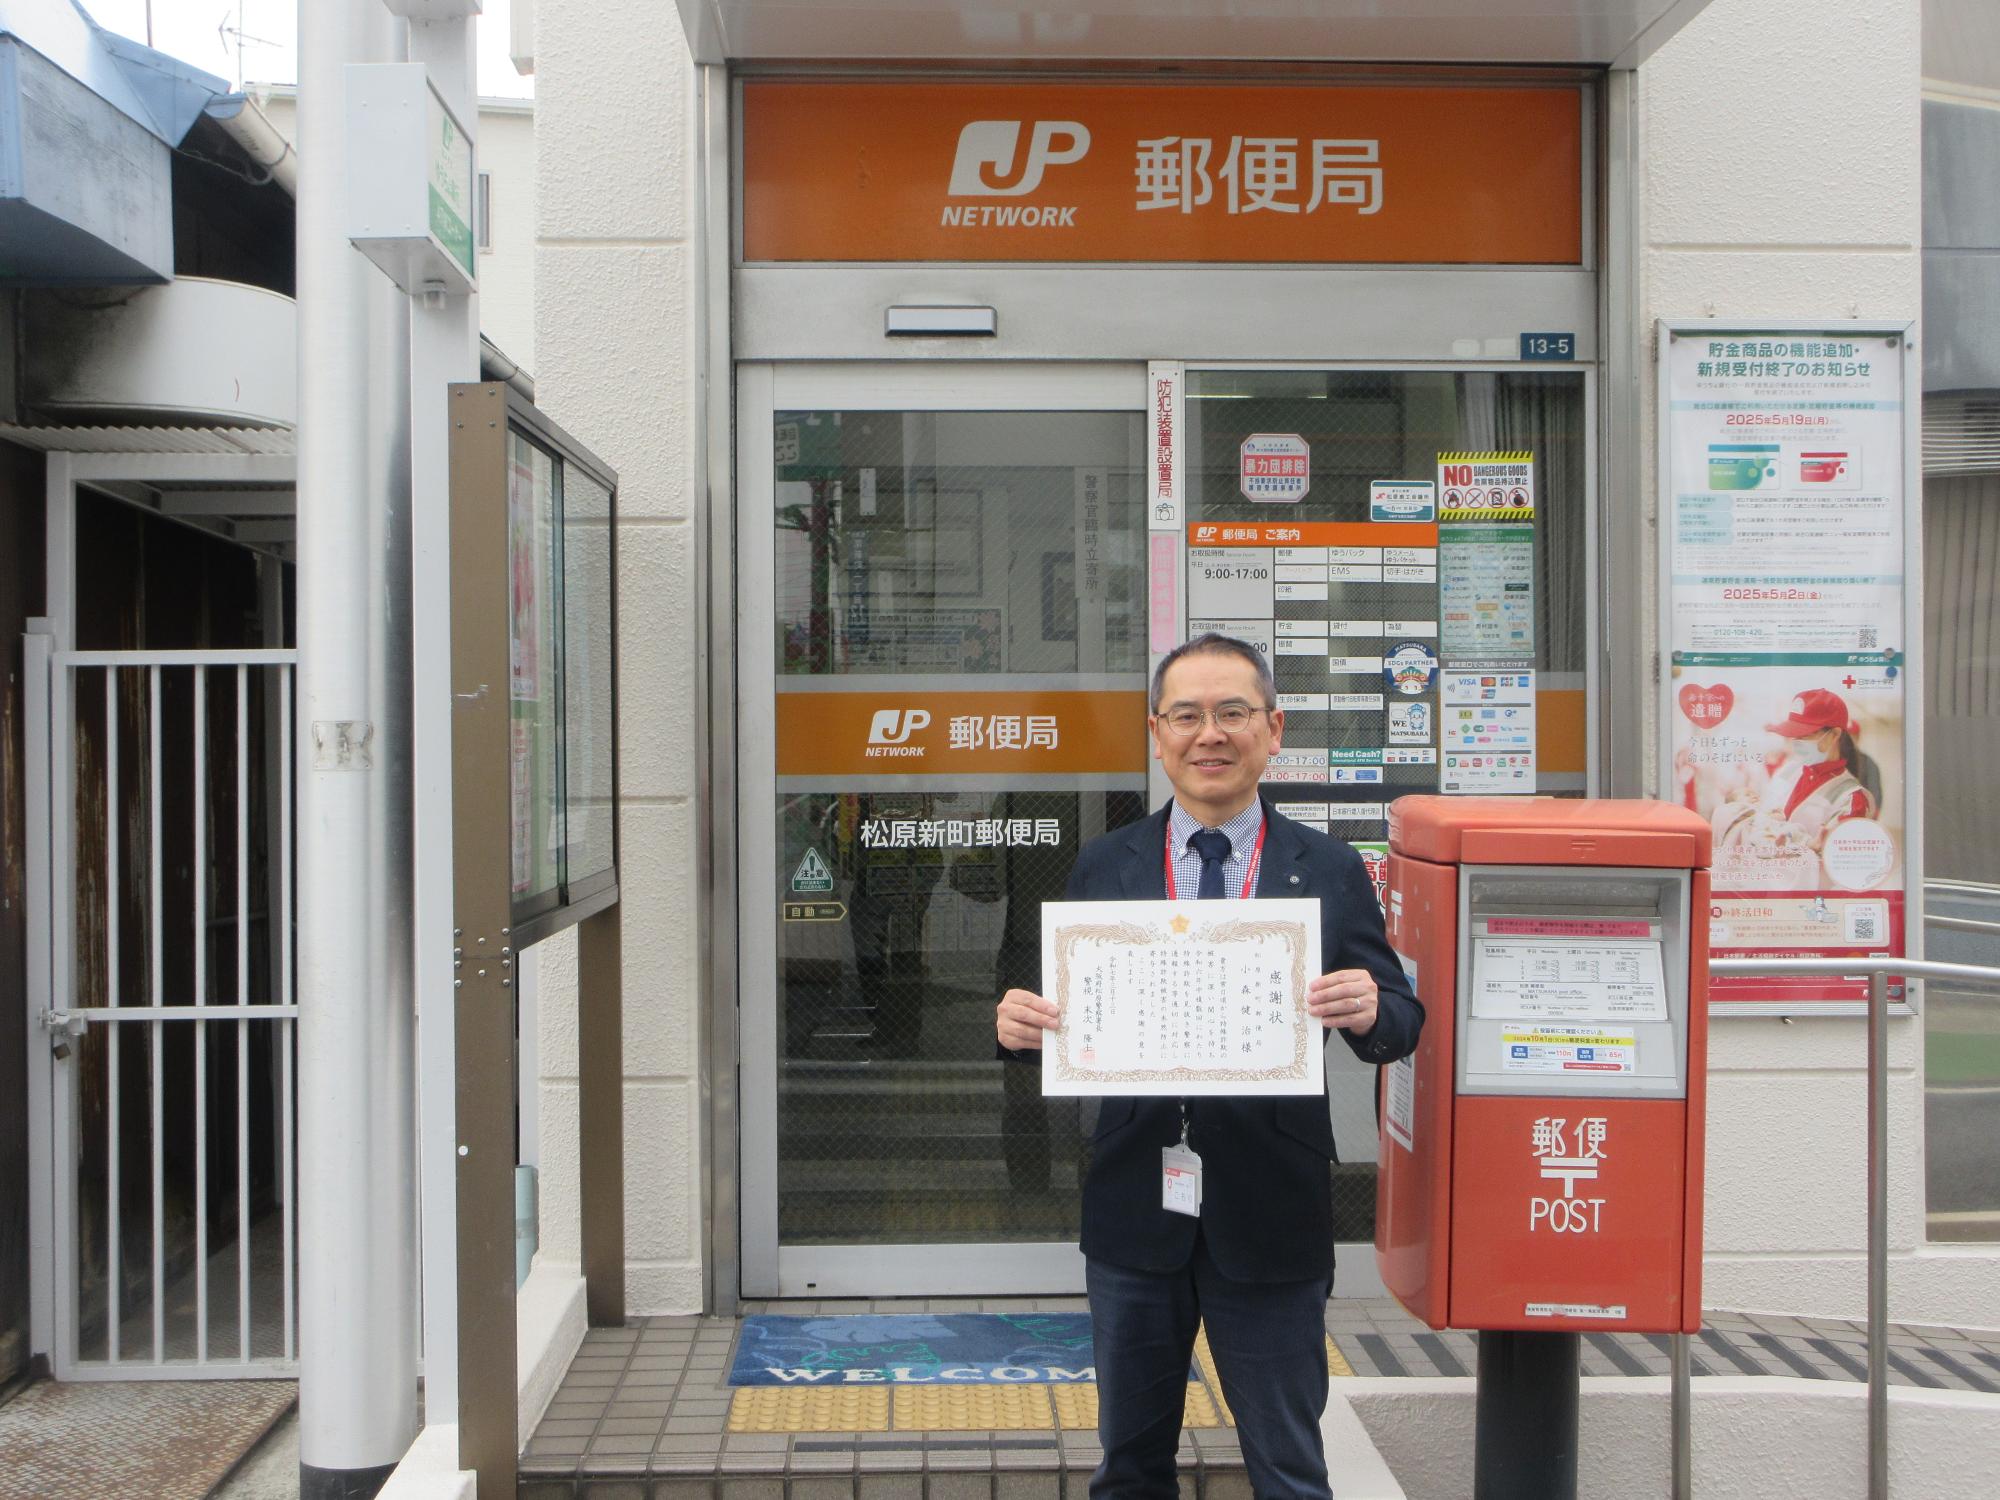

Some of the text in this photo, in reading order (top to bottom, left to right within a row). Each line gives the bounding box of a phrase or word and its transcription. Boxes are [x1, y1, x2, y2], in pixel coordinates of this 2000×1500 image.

[948, 120, 1090, 196] JP
[1134, 136, 1384, 215] 郵便局
[941, 207, 1078, 227] NETWORK
[1529, 339, 1568, 353] 13-5
[1697, 362, 1871, 377] 新規受付終了のお知らせ
[1157, 380, 1172, 498] 防犯装置設置局
[1245, 458, 1305, 474] 暴力団排除
[1444, 465, 1528, 486] NO DANGEROUS GOODS
[1084, 474, 1098, 590] 警察官臨時立寄所
[1222, 528, 1300, 541] 郵便局 ご案内
[1205, 568, 1268, 579] 9:00-17:00
[1332, 567, 1350, 575] EMS
[1395, 641, 1427, 652] MATSUBARA
[1691, 703, 1722, 718] 遺贈
[868, 710, 930, 743] JP
[950, 716, 1057, 750] 郵便局
[1689, 736, 1748, 748] 今日もずっと
[865, 747, 924, 757] NETWORK
[1265, 773, 1326, 781] 9:00-17:00
[861, 819, 1060, 848] 松原新町郵便局
[792, 907, 815, 917] 自動
[1083, 976, 1094, 996] 警視
[1269, 970, 1284, 1024] 感謝状
[1532, 1117, 1608, 1159] 郵便
[1531, 1198, 1606, 1233] POST
[763, 1367, 1097, 1384] WELCOM
